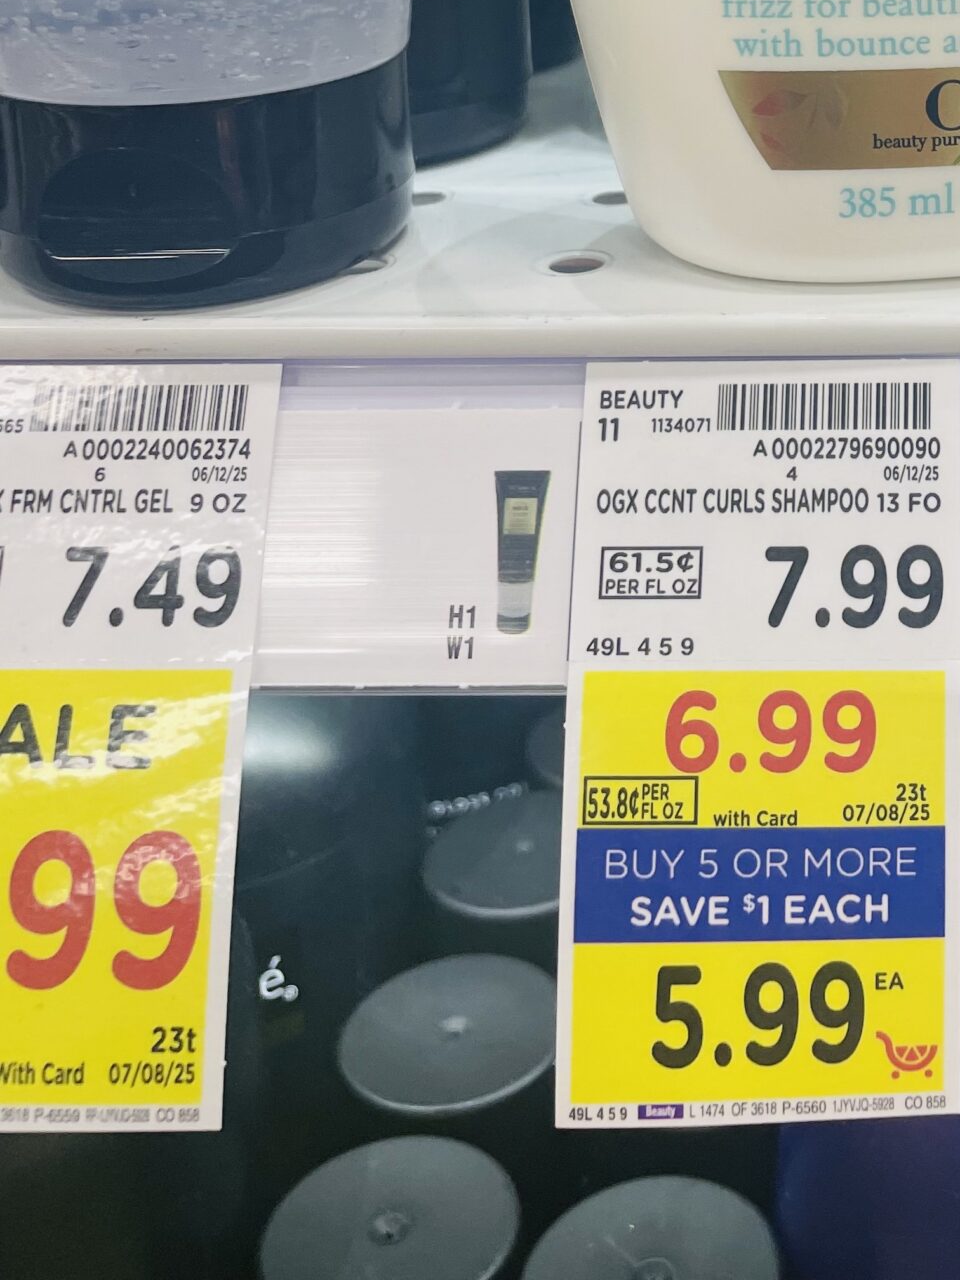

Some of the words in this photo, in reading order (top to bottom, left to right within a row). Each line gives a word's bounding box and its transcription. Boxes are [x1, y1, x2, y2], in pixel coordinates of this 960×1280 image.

[733, 28, 803, 60] with
[816, 27, 930, 58] bounce
[873, 132, 927, 154] beauty
[838, 187, 896, 219] 385
[908, 182, 953, 216] ml
[600, 390, 683, 409] BEAUTY
[599, 418, 619, 442] 11
[651, 418, 711, 433] 1134071
[95, 467, 105, 482] 6
[192, 466, 247, 483] 06/12/25
[787, 467, 797, 481] 4
[883, 466, 939, 481] 06/12/25
[10, 489, 53, 513] FRM
[60, 489, 126, 513] CNTRL
[135, 489, 173, 513] GEL
[190, 493, 203, 513] 9
[212, 493, 247, 513] OZ
[597, 489, 638, 513] OGX
[645, 489, 697, 513] CCNT
[703, 489, 765, 513] CURLS
[771, 488, 869, 512] SHAMPOO
[877, 493, 899, 512] 13
[909, 493, 941, 512] FO
[609, 552, 694, 573] 61.5¢
[61, 546, 242, 628] 7.49
[605, 580, 639, 594] PER
[646, 580, 665, 594] FL
[672, 580, 697, 594] OZ
[765, 544, 943, 628] 7.99
[448, 604, 476, 629] H1
[447, 636, 475, 660] W1
[586, 638, 629, 656] 49L
[638, 638, 650, 655] 4
[659, 638, 672, 655] 5
[681, 638, 694, 655] 9
[665, 690, 876, 773] 6.99
[587, 788, 639, 819] 53.8¢
[642, 784, 669, 800] PER
[896, 783, 926, 801] 23t
[642, 803, 659, 819] FL
[663, 803, 683, 819] OZ
[714, 812, 750, 826] with
[757, 811, 797, 826] Card
[843, 804, 930, 822] 07/08/25
[605, 849, 684, 879] BUY
[699, 849, 718, 878] 5
[734, 849, 788, 879] OR
[805, 847, 917, 878] MORE
[630, 896, 729, 926] SAVE
[743, 893, 769, 924] $1
[784, 893, 889, 924] EACH
[875, 973, 903, 990] EA
[652, 961, 865, 1069] 5.99
[151, 1026, 197, 1053] 23t
[42, 1061, 84, 1085] Card
[108, 1061, 195, 1087] 07/08/25
[569, 1108, 592, 1121] 49L
[597, 1108, 604, 1120] 4
[608, 1108, 616, 1120] 5
[620, 1107, 627, 1120] 9
[689, 1106, 696, 1118] L
[701, 1105, 725, 1118] 1474
[731, 1104, 748, 1117] OF
[751, 1102, 777, 1116] 3618
[782, 1100, 826, 1114] P-6560
[904, 1097, 923, 1110] CO
[927, 1096, 946, 1109] 858
